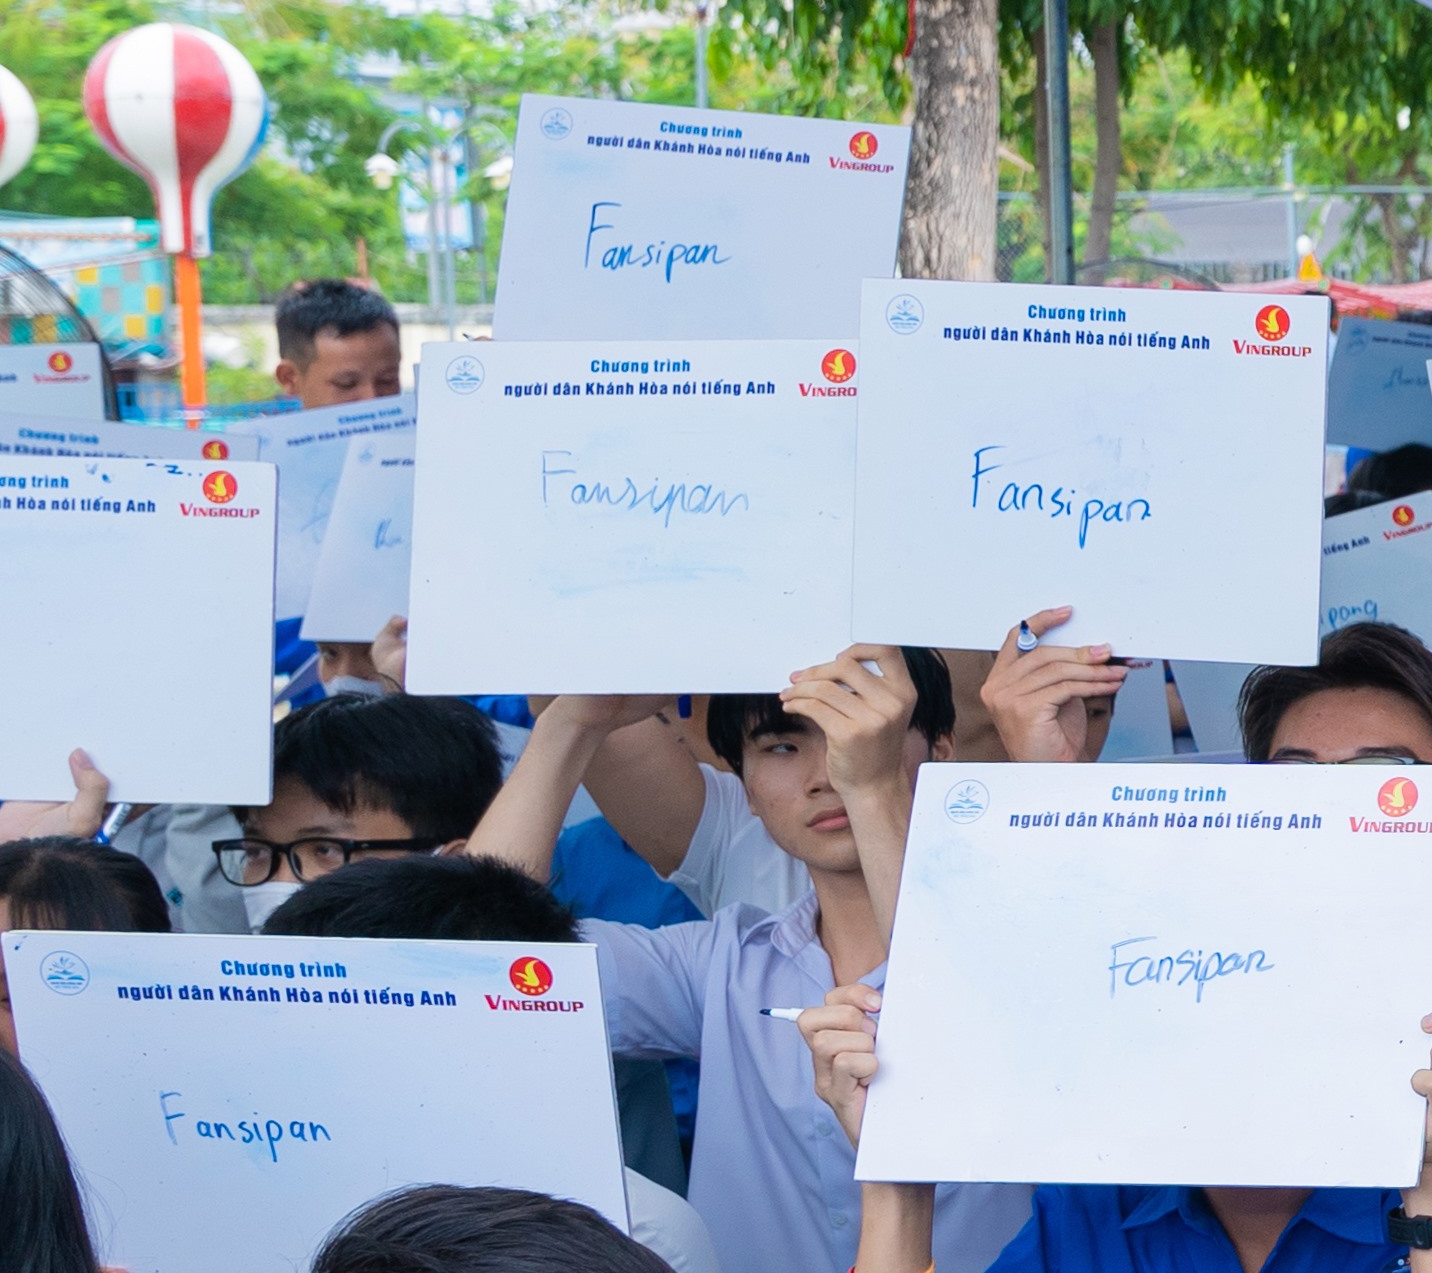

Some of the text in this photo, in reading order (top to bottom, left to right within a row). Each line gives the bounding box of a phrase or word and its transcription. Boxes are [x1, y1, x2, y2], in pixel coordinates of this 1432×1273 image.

[659, 120, 742, 139] Chương trình
[586, 135, 810, 163] người dân Khánh Hòa nói tiếng Anh
[828, 156, 894, 173] VINGROUP
[586, 201, 732, 282] Fansipan
[1232, 338, 1312, 357] VINGROUP
[179, 501, 260, 518] VINGROUP
[972, 445, 1151, 550] Fansipan
[1109, 935, 1275, 1003] Fansipan
[484, 992, 584, 1012] VINGROUP
[159, 1090, 331, 1163] Fansipan
